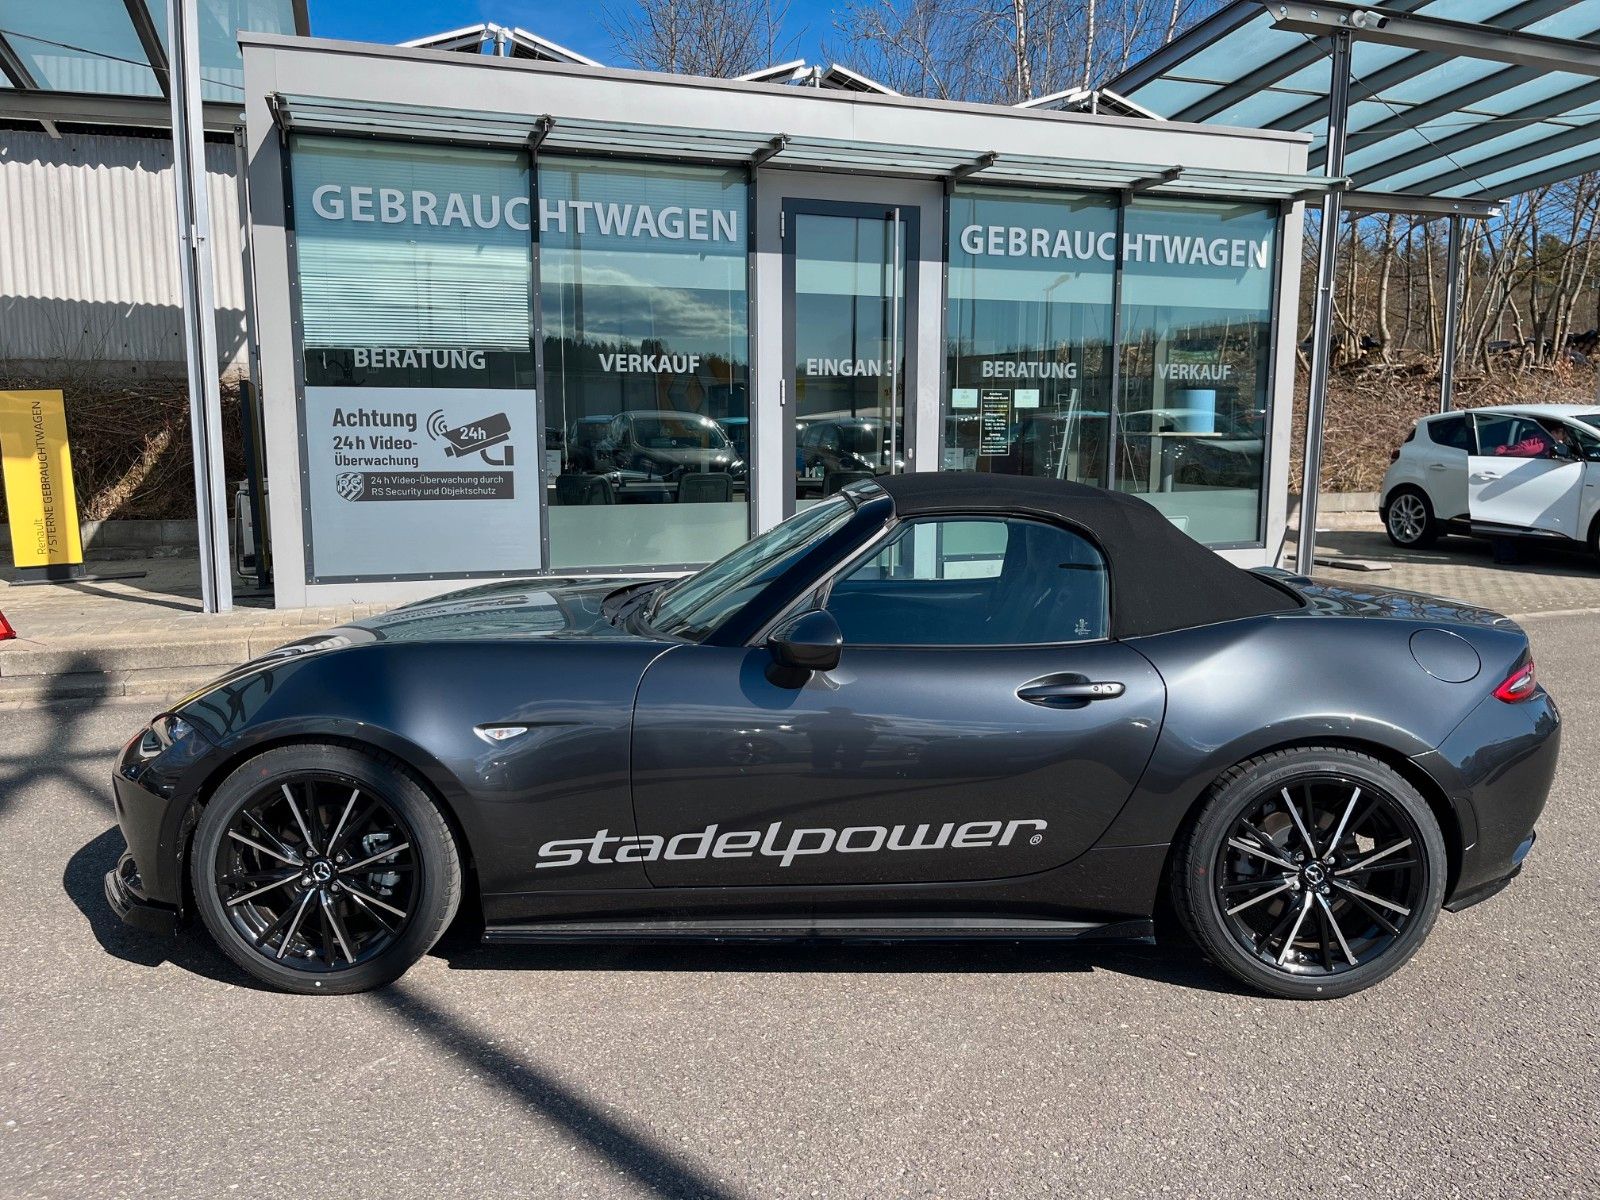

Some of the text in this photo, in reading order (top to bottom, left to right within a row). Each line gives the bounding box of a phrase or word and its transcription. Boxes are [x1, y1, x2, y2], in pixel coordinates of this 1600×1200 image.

[312, 184, 738, 242] GEBRAUCHTWAGEN
[960, 224, 1268, 269] GEBRAUCHTWAGEN
[353, 348, 486, 370] BERATUNG
[598, 353, 700, 374] VERKAUF
[982, 360, 1077, 379] BERATUNG
[1158, 363, 1232, 381] VERKAUF
[332, 408, 418, 433] Achtung
[369, 435, 418, 451] Video-
[460, 427, 487, 440] 24h
[32, 401, 53, 505] GEBRAUCHTWAGEN
[334, 452, 419, 468] Überwachung
[391, 474, 479, 486] Video-Überwachung
[480, 476, 504, 485] durch
[372, 486, 496, 498] RS Security und Objektschutz
[44, 505, 58, 546] STERNE
[34, 518, 46, 555] Renault
